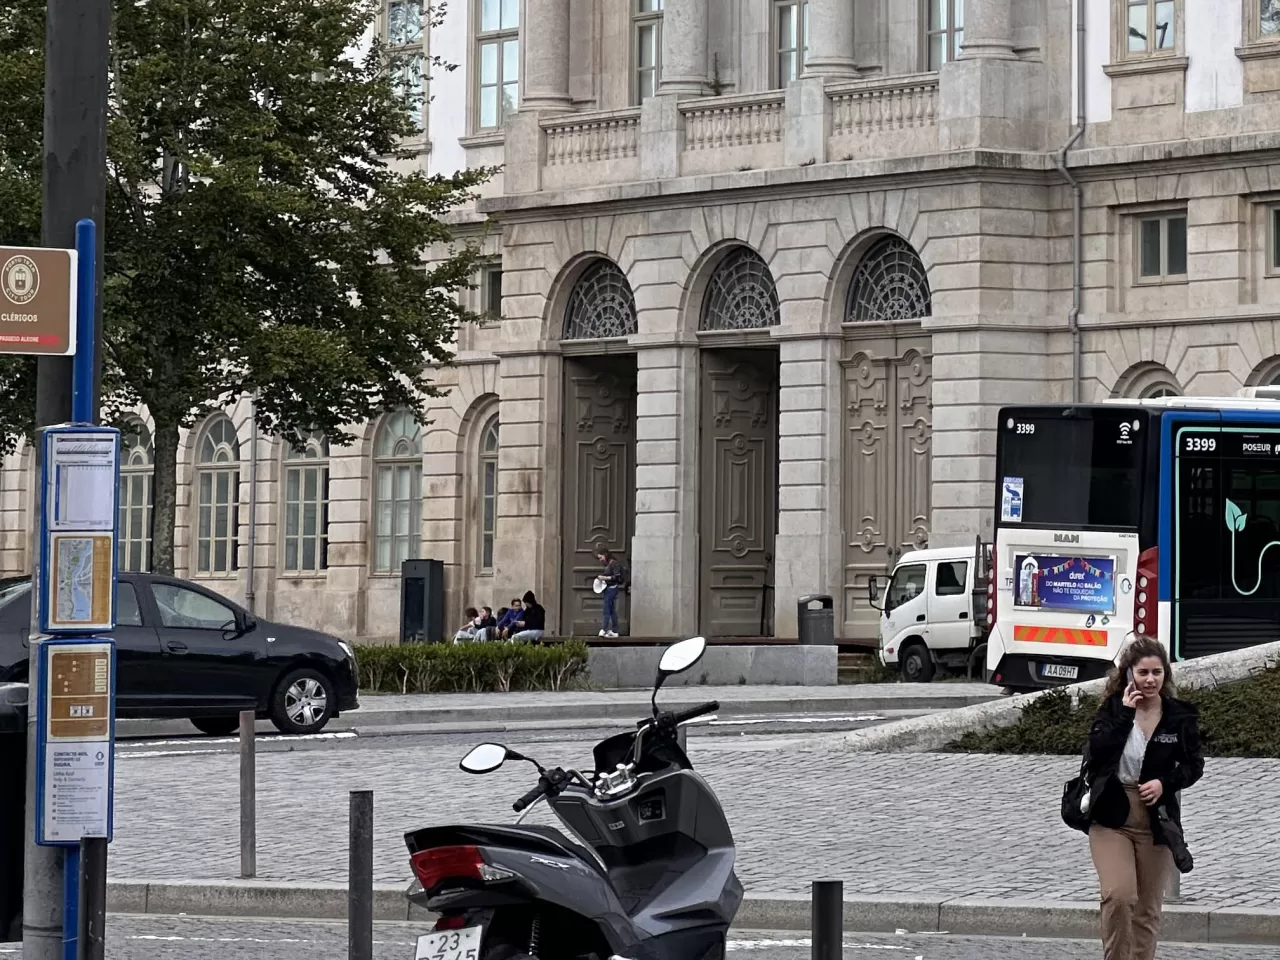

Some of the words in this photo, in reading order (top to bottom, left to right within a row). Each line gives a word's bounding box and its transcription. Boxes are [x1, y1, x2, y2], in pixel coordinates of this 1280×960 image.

[6, 287, 17, 300] CITY
[1, 312, 38, 322] CLÉRIGOS
[1016, 423, 1035, 434] 3399
[1185, 438, 1216, 451] 3399
[1242, 443, 1271, 452] POSEUR
[1054, 534, 1079, 543] MAN
[437, 932, 460, 953] 23
